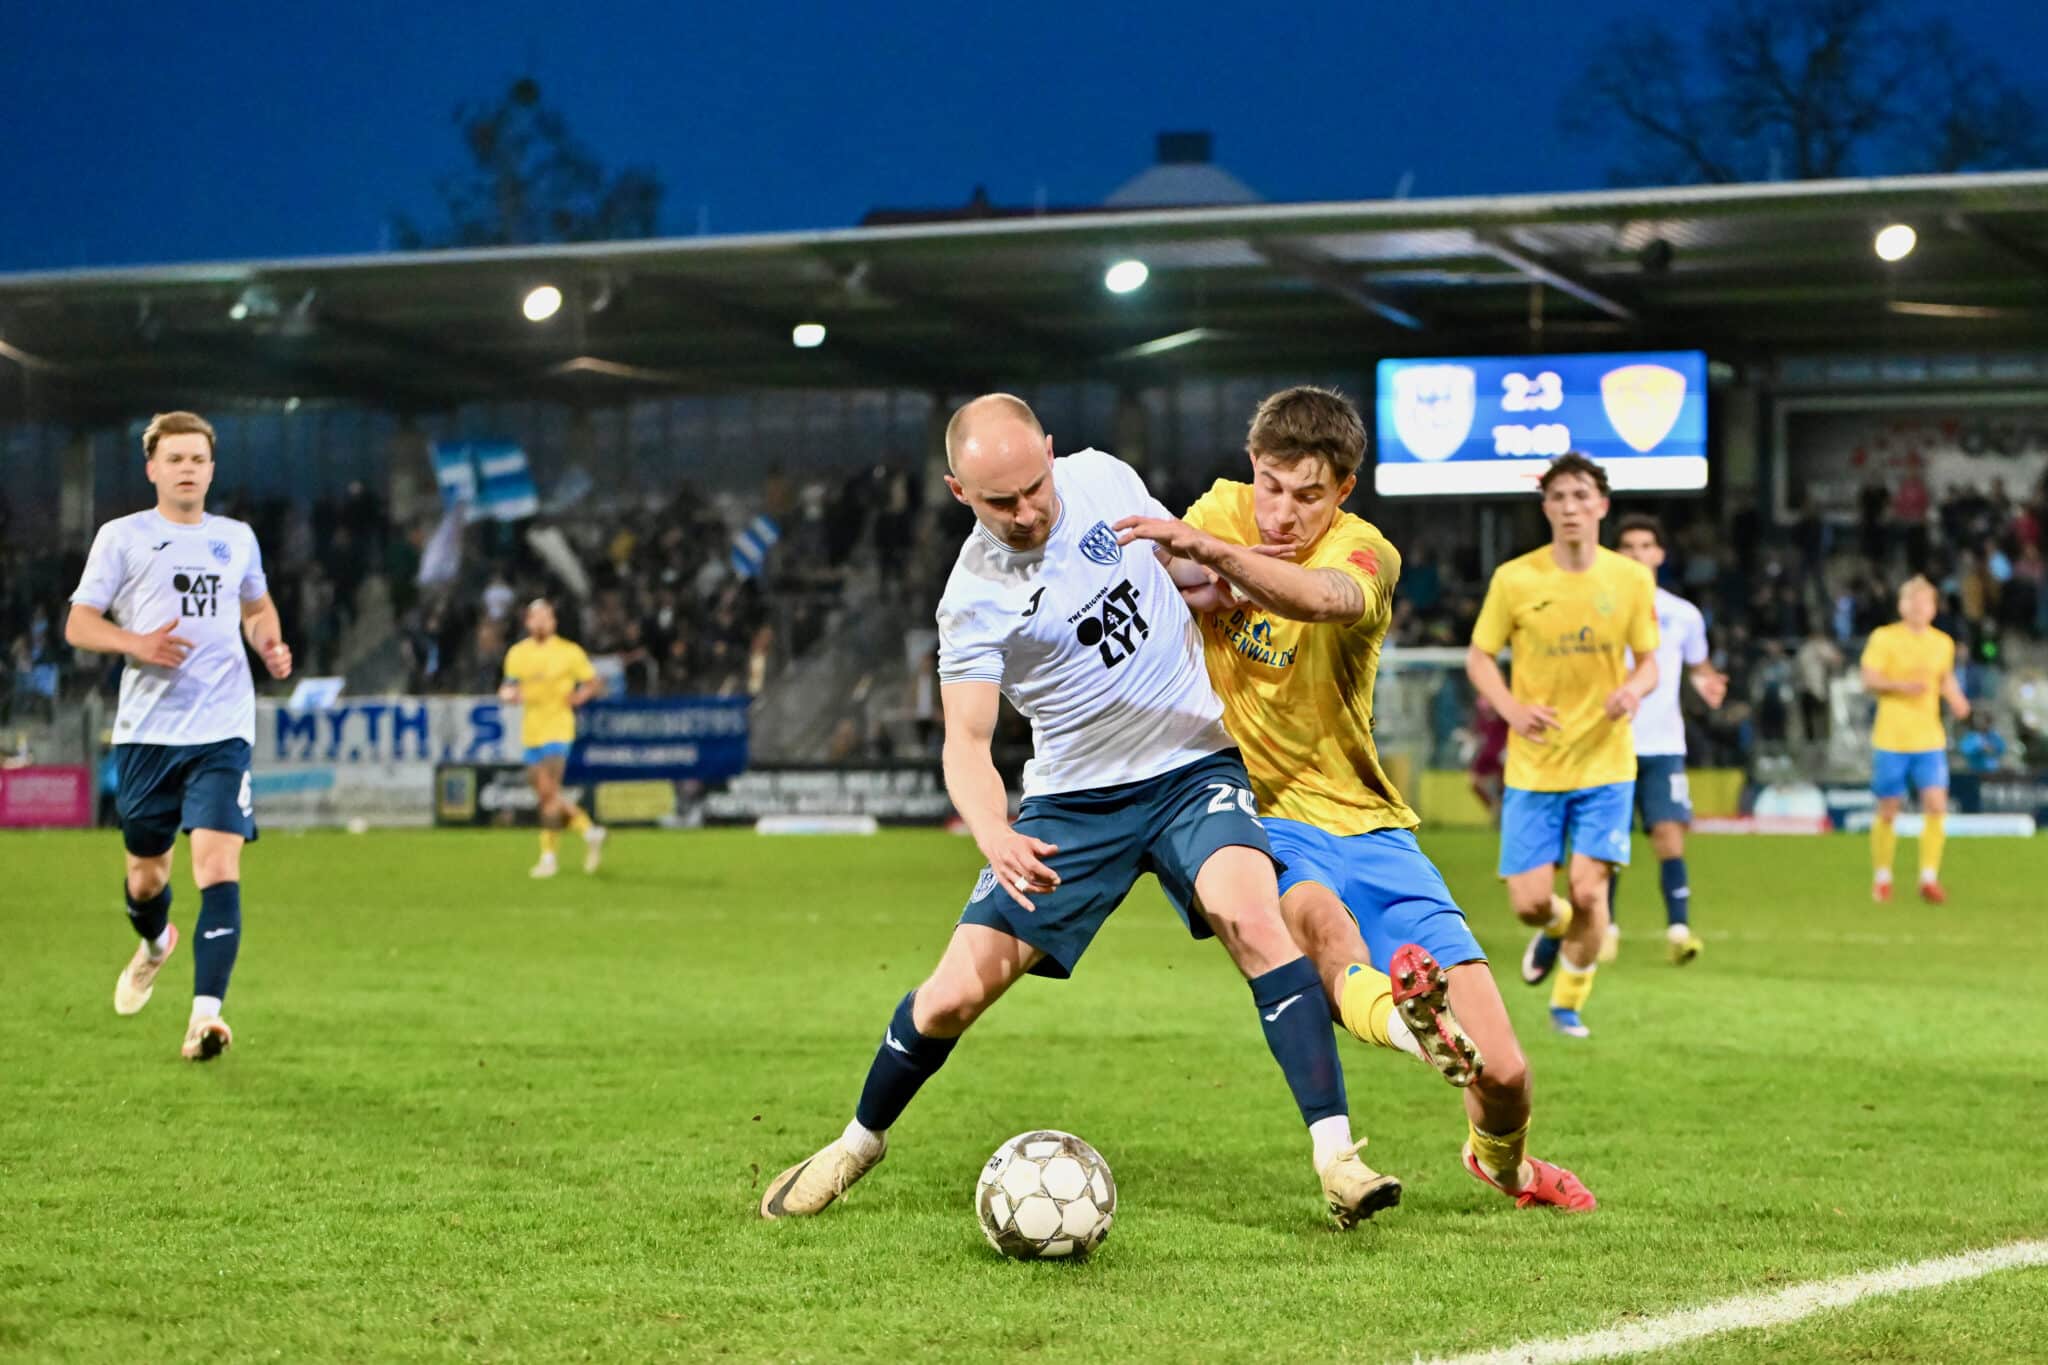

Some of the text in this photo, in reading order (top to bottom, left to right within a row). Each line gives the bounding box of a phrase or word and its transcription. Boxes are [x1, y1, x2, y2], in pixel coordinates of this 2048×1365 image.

[182, 596, 217, 617] LY!
[1067, 586, 1109, 624] THE ORIGINAL
[1207, 783, 1257, 818] 20
